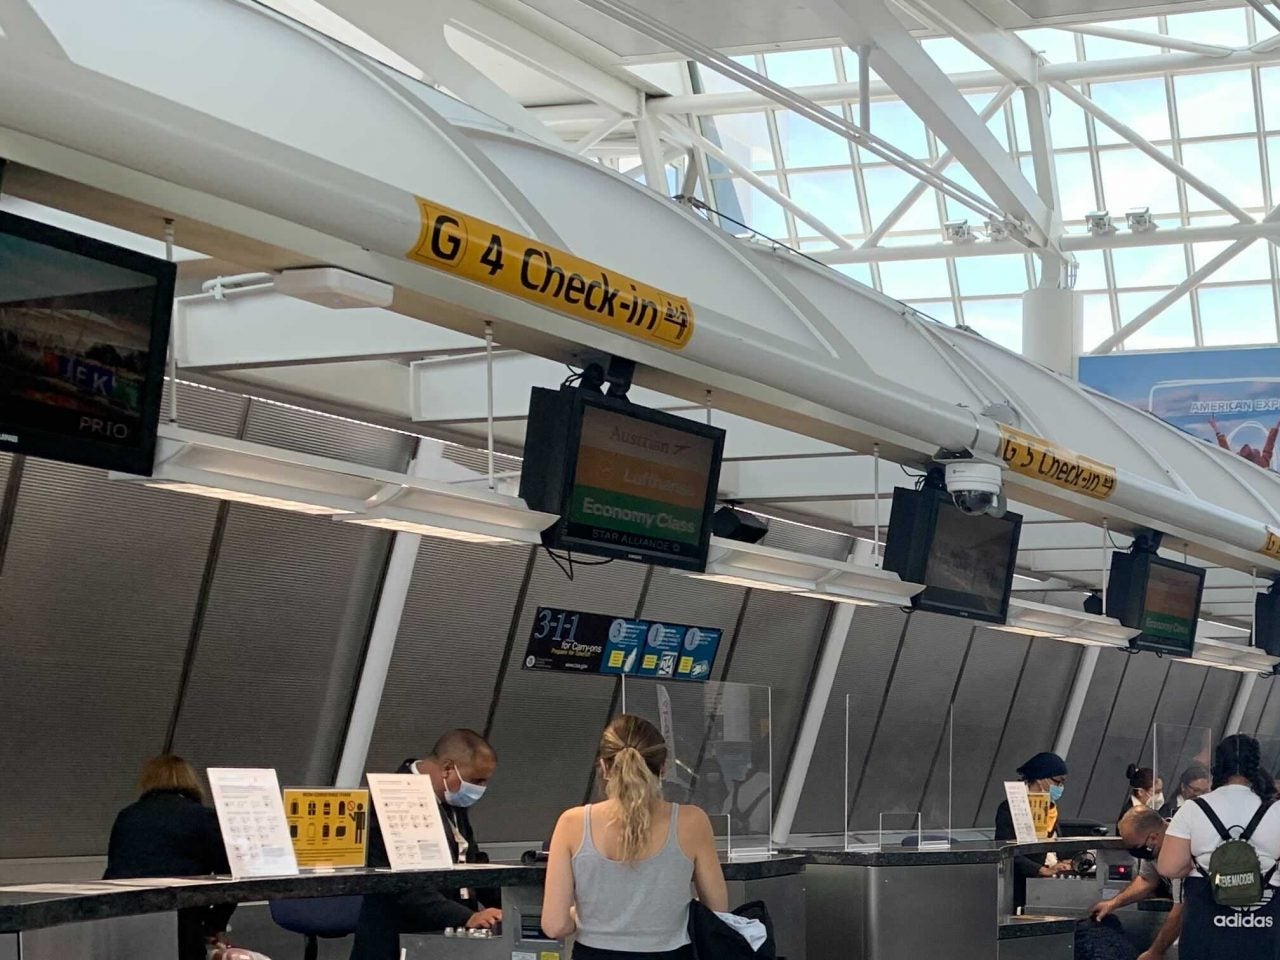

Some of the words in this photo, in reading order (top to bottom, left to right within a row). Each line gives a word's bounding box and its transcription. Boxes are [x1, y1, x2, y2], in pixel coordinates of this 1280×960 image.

[431, 214, 461, 261] G
[480, 233, 504, 276] 4
[520, 247, 658, 331] Check-in
[1189, 399, 1253, 414] AMERICAN
[79, 416, 128, 439] PRIO
[609, 426, 670, 454] Austrian
[1038, 449, 1100, 492] Check-in
[583, 497, 657, 526] Economy
[656, 512, 696, 533] Class
[592, 529, 619, 541] STAR
[620, 532, 670, 551] ALLIANCE
[534, 609, 579, 642] 3-1-1
[1213, 912, 1273, 928] adidas
